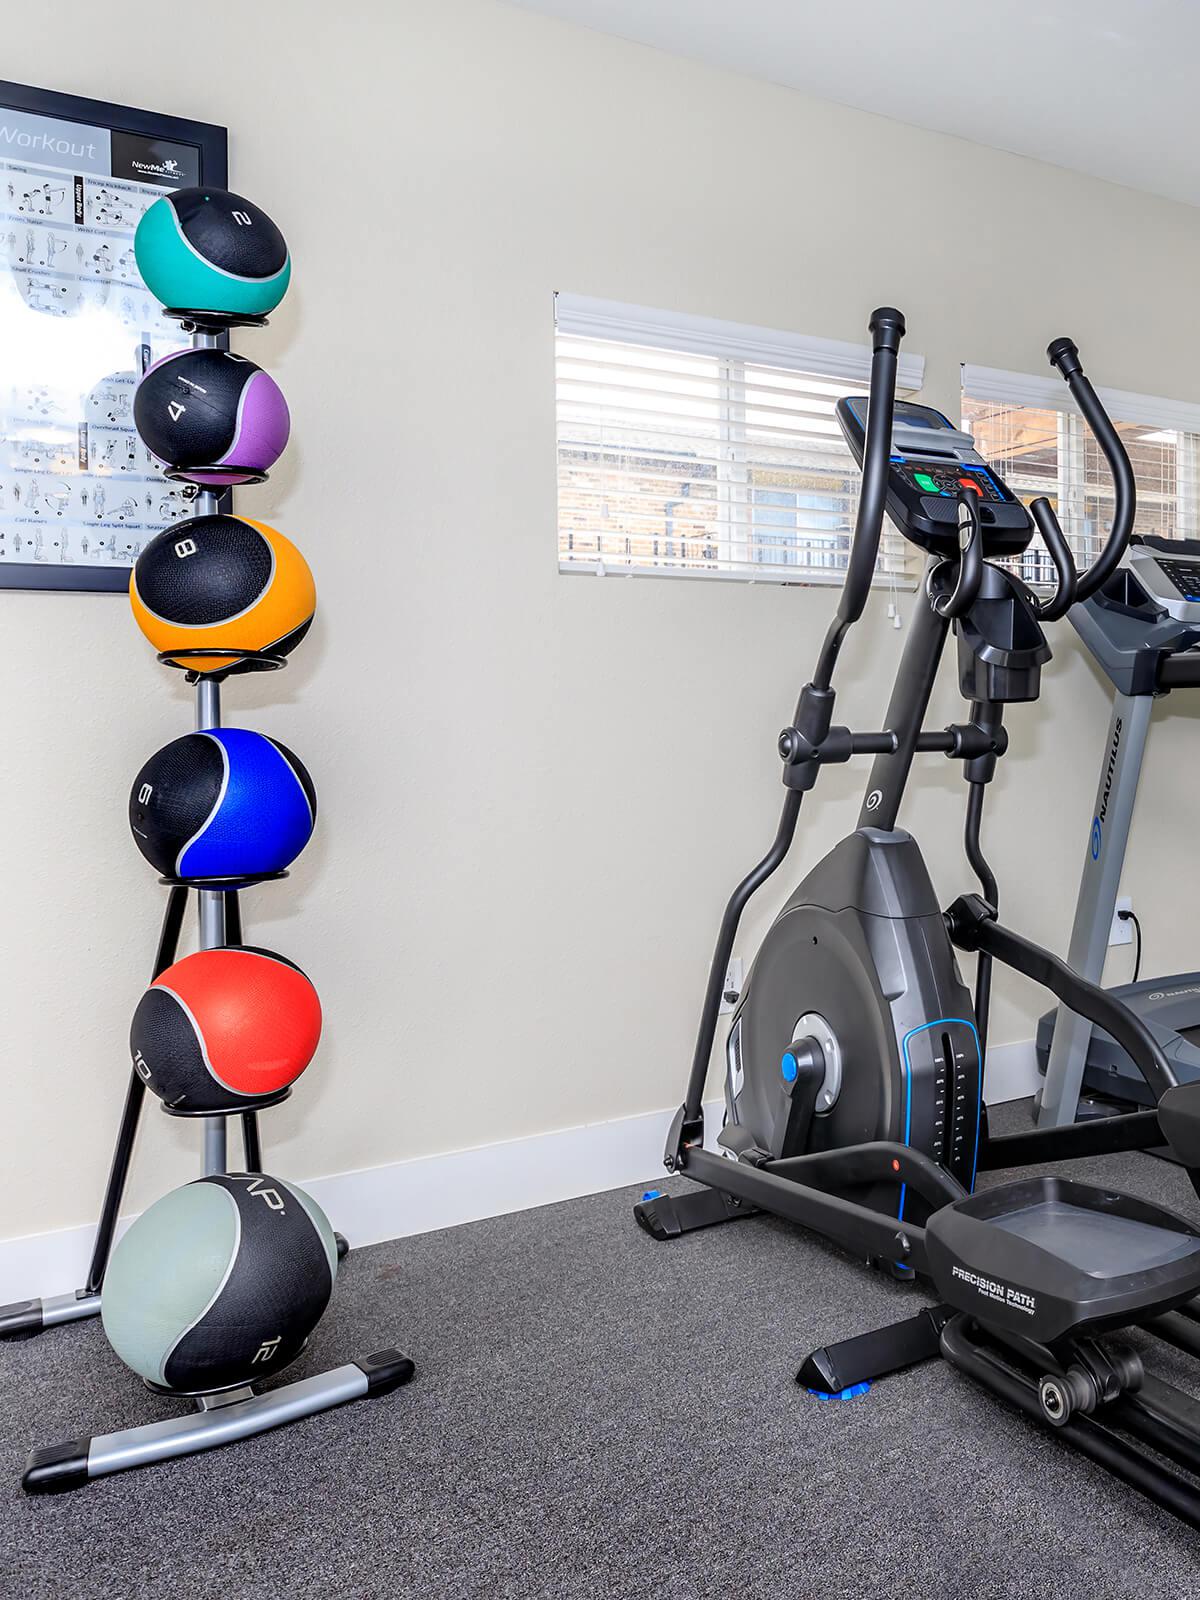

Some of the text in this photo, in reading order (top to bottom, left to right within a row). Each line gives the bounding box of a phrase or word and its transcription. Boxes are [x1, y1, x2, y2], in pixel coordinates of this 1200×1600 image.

[131, 160, 165, 173] NewMe
[231, 210, 252, 226] 2
[167, 400, 186, 422] 4
[174, 538, 197, 558] 8
[1099, 717, 1123, 823] NAUTILUS
[134, 1049, 152, 1080] 10
[951, 1265, 1036, 1309] PRECISION PATH
[251, 1335, 282, 1364] 12
